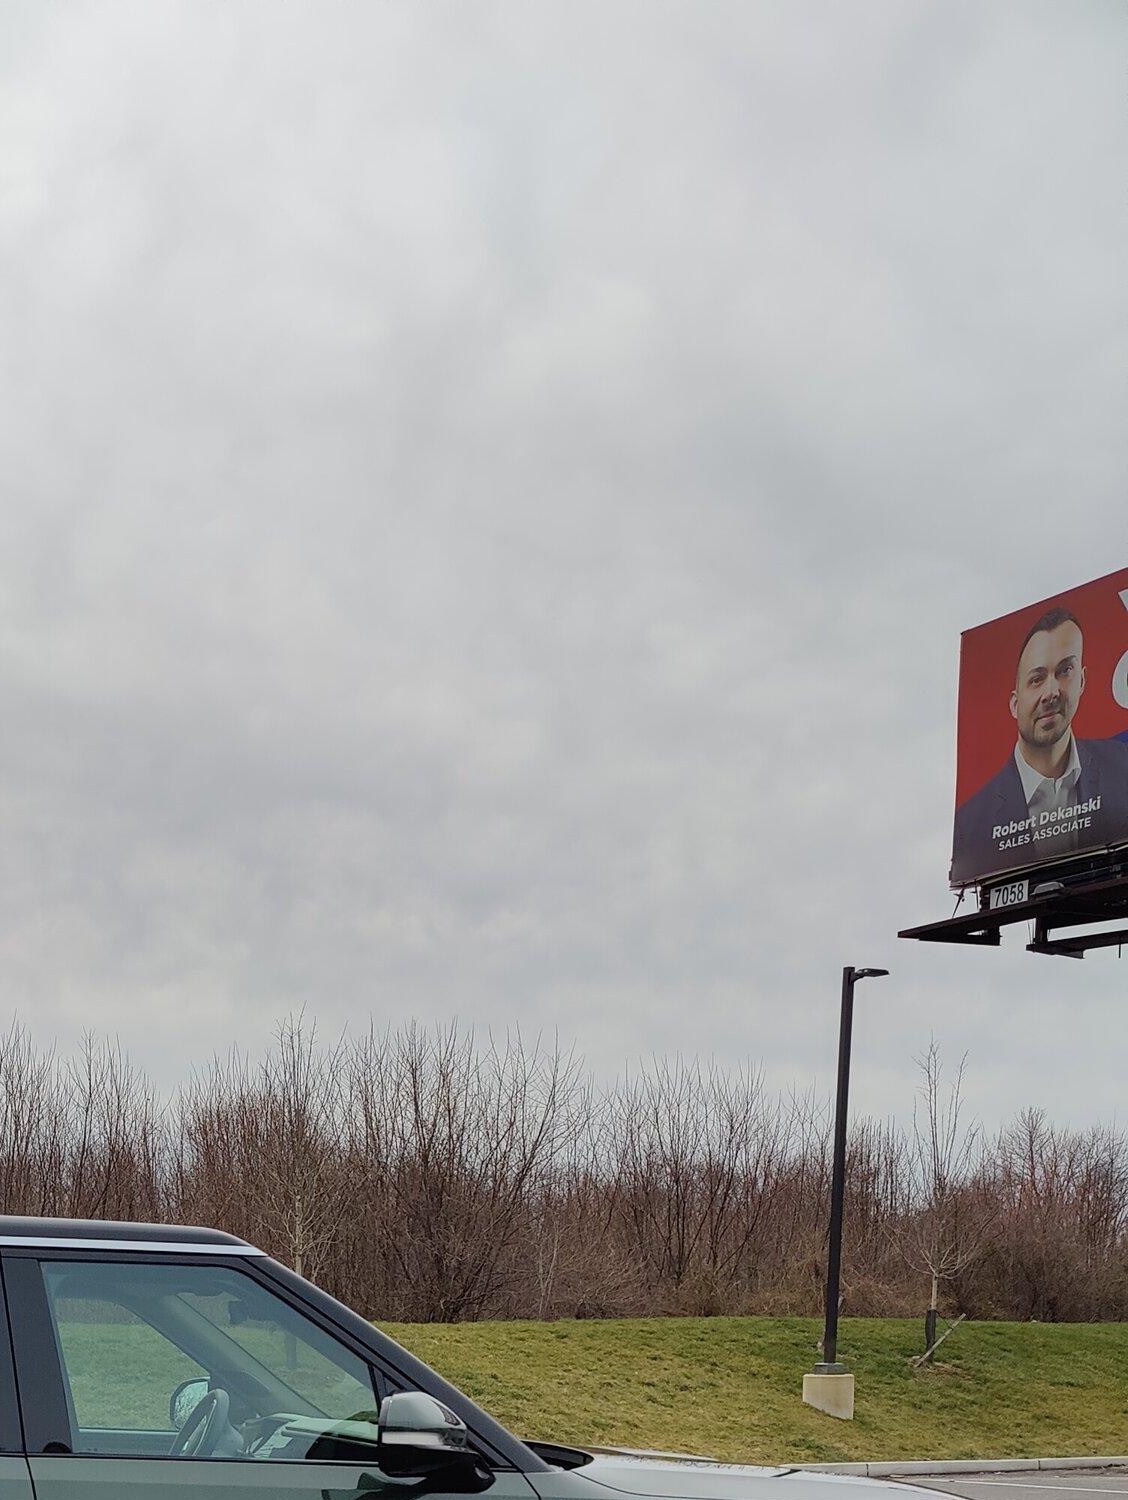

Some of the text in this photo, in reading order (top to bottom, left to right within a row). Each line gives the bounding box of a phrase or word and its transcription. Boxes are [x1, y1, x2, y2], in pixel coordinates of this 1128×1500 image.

[992, 796, 1101, 839] Robert Dekanski
[999, 817, 1091, 850] SALES ASSOCIATE
[995, 883, 1024, 907] 7058
